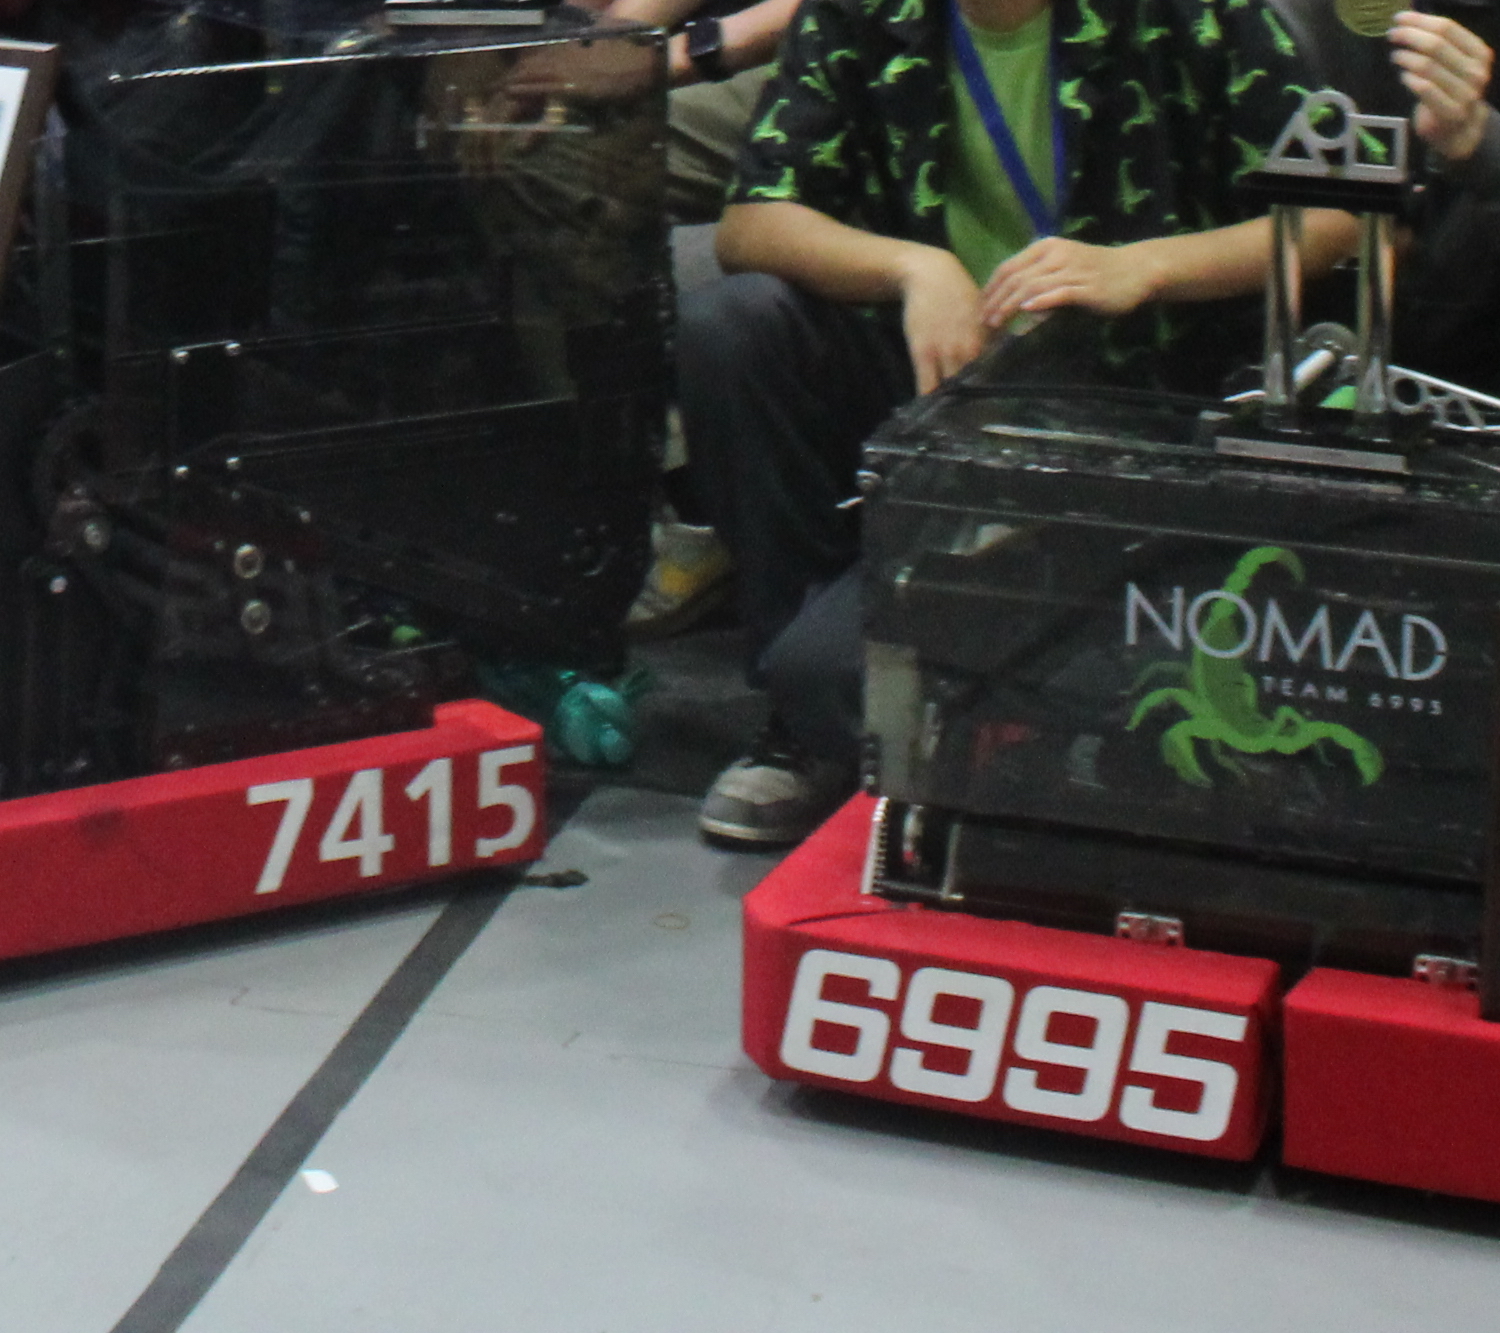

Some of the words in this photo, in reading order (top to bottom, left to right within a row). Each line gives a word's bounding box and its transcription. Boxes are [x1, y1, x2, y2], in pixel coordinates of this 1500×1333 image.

[1125, 581, 1448, 681] NOMAD
[1260, 676, 1348, 704] TEAM
[246, 745, 536, 895] 7415
[778, 946, 1248, 1142] 6995
